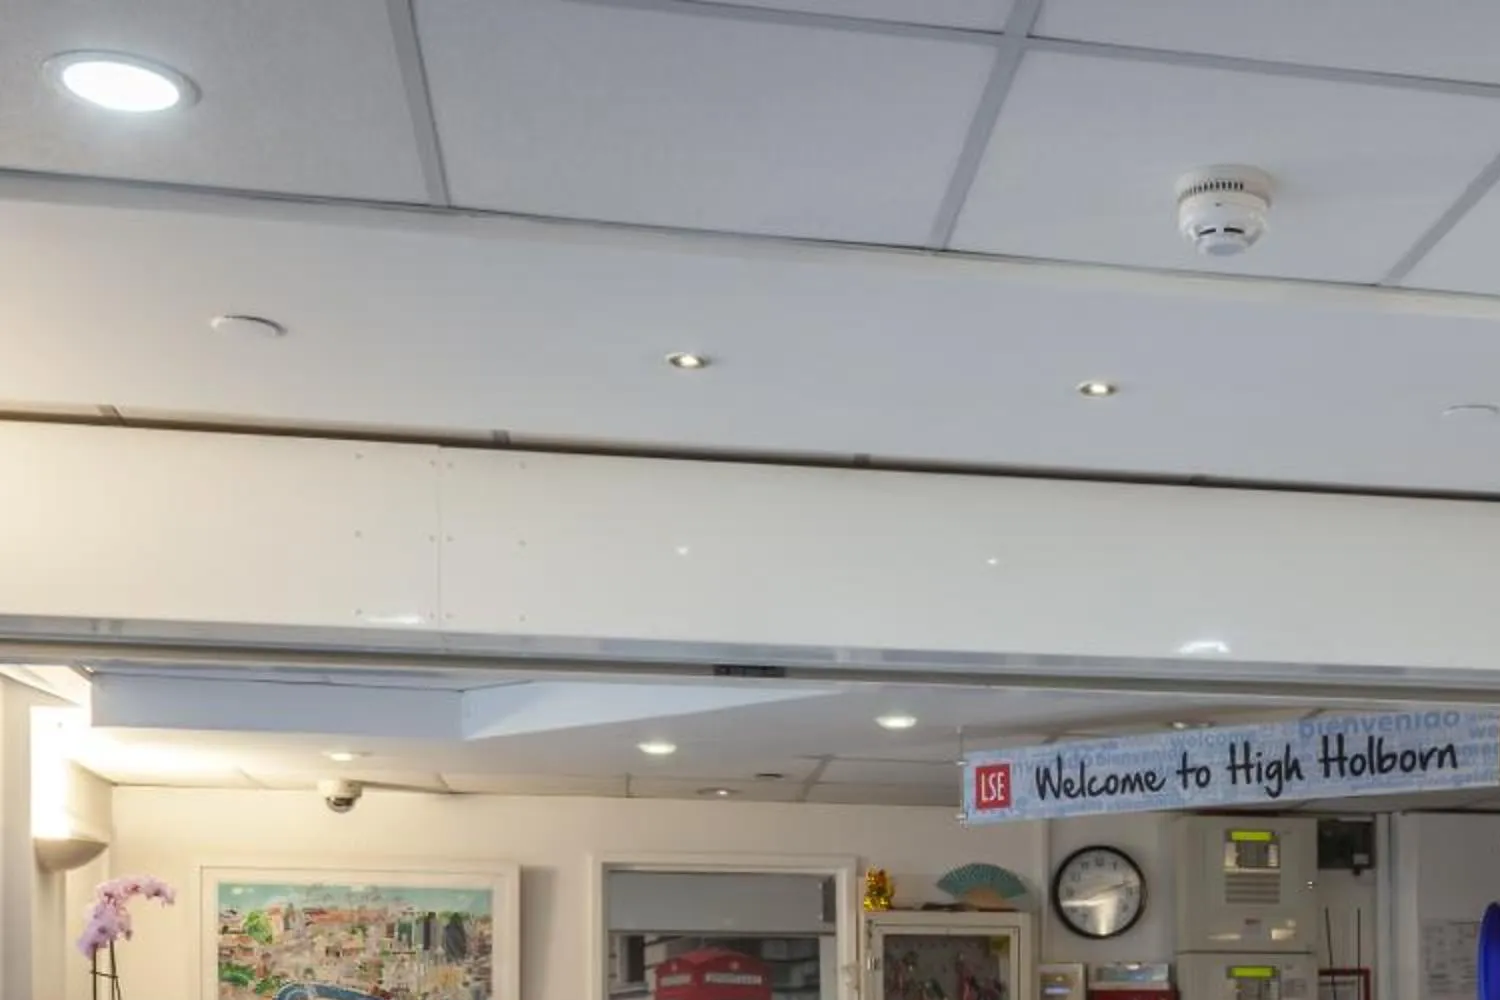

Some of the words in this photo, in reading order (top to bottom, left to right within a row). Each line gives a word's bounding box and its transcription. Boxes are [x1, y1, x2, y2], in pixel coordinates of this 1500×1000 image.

[980, 770, 1005, 802] LSE
[1035, 751, 1166, 800] Welcome
[1176, 751, 1211, 790] to
[1226, 740, 1304, 799] High
[1319, 732, 1459, 778] Holborn
